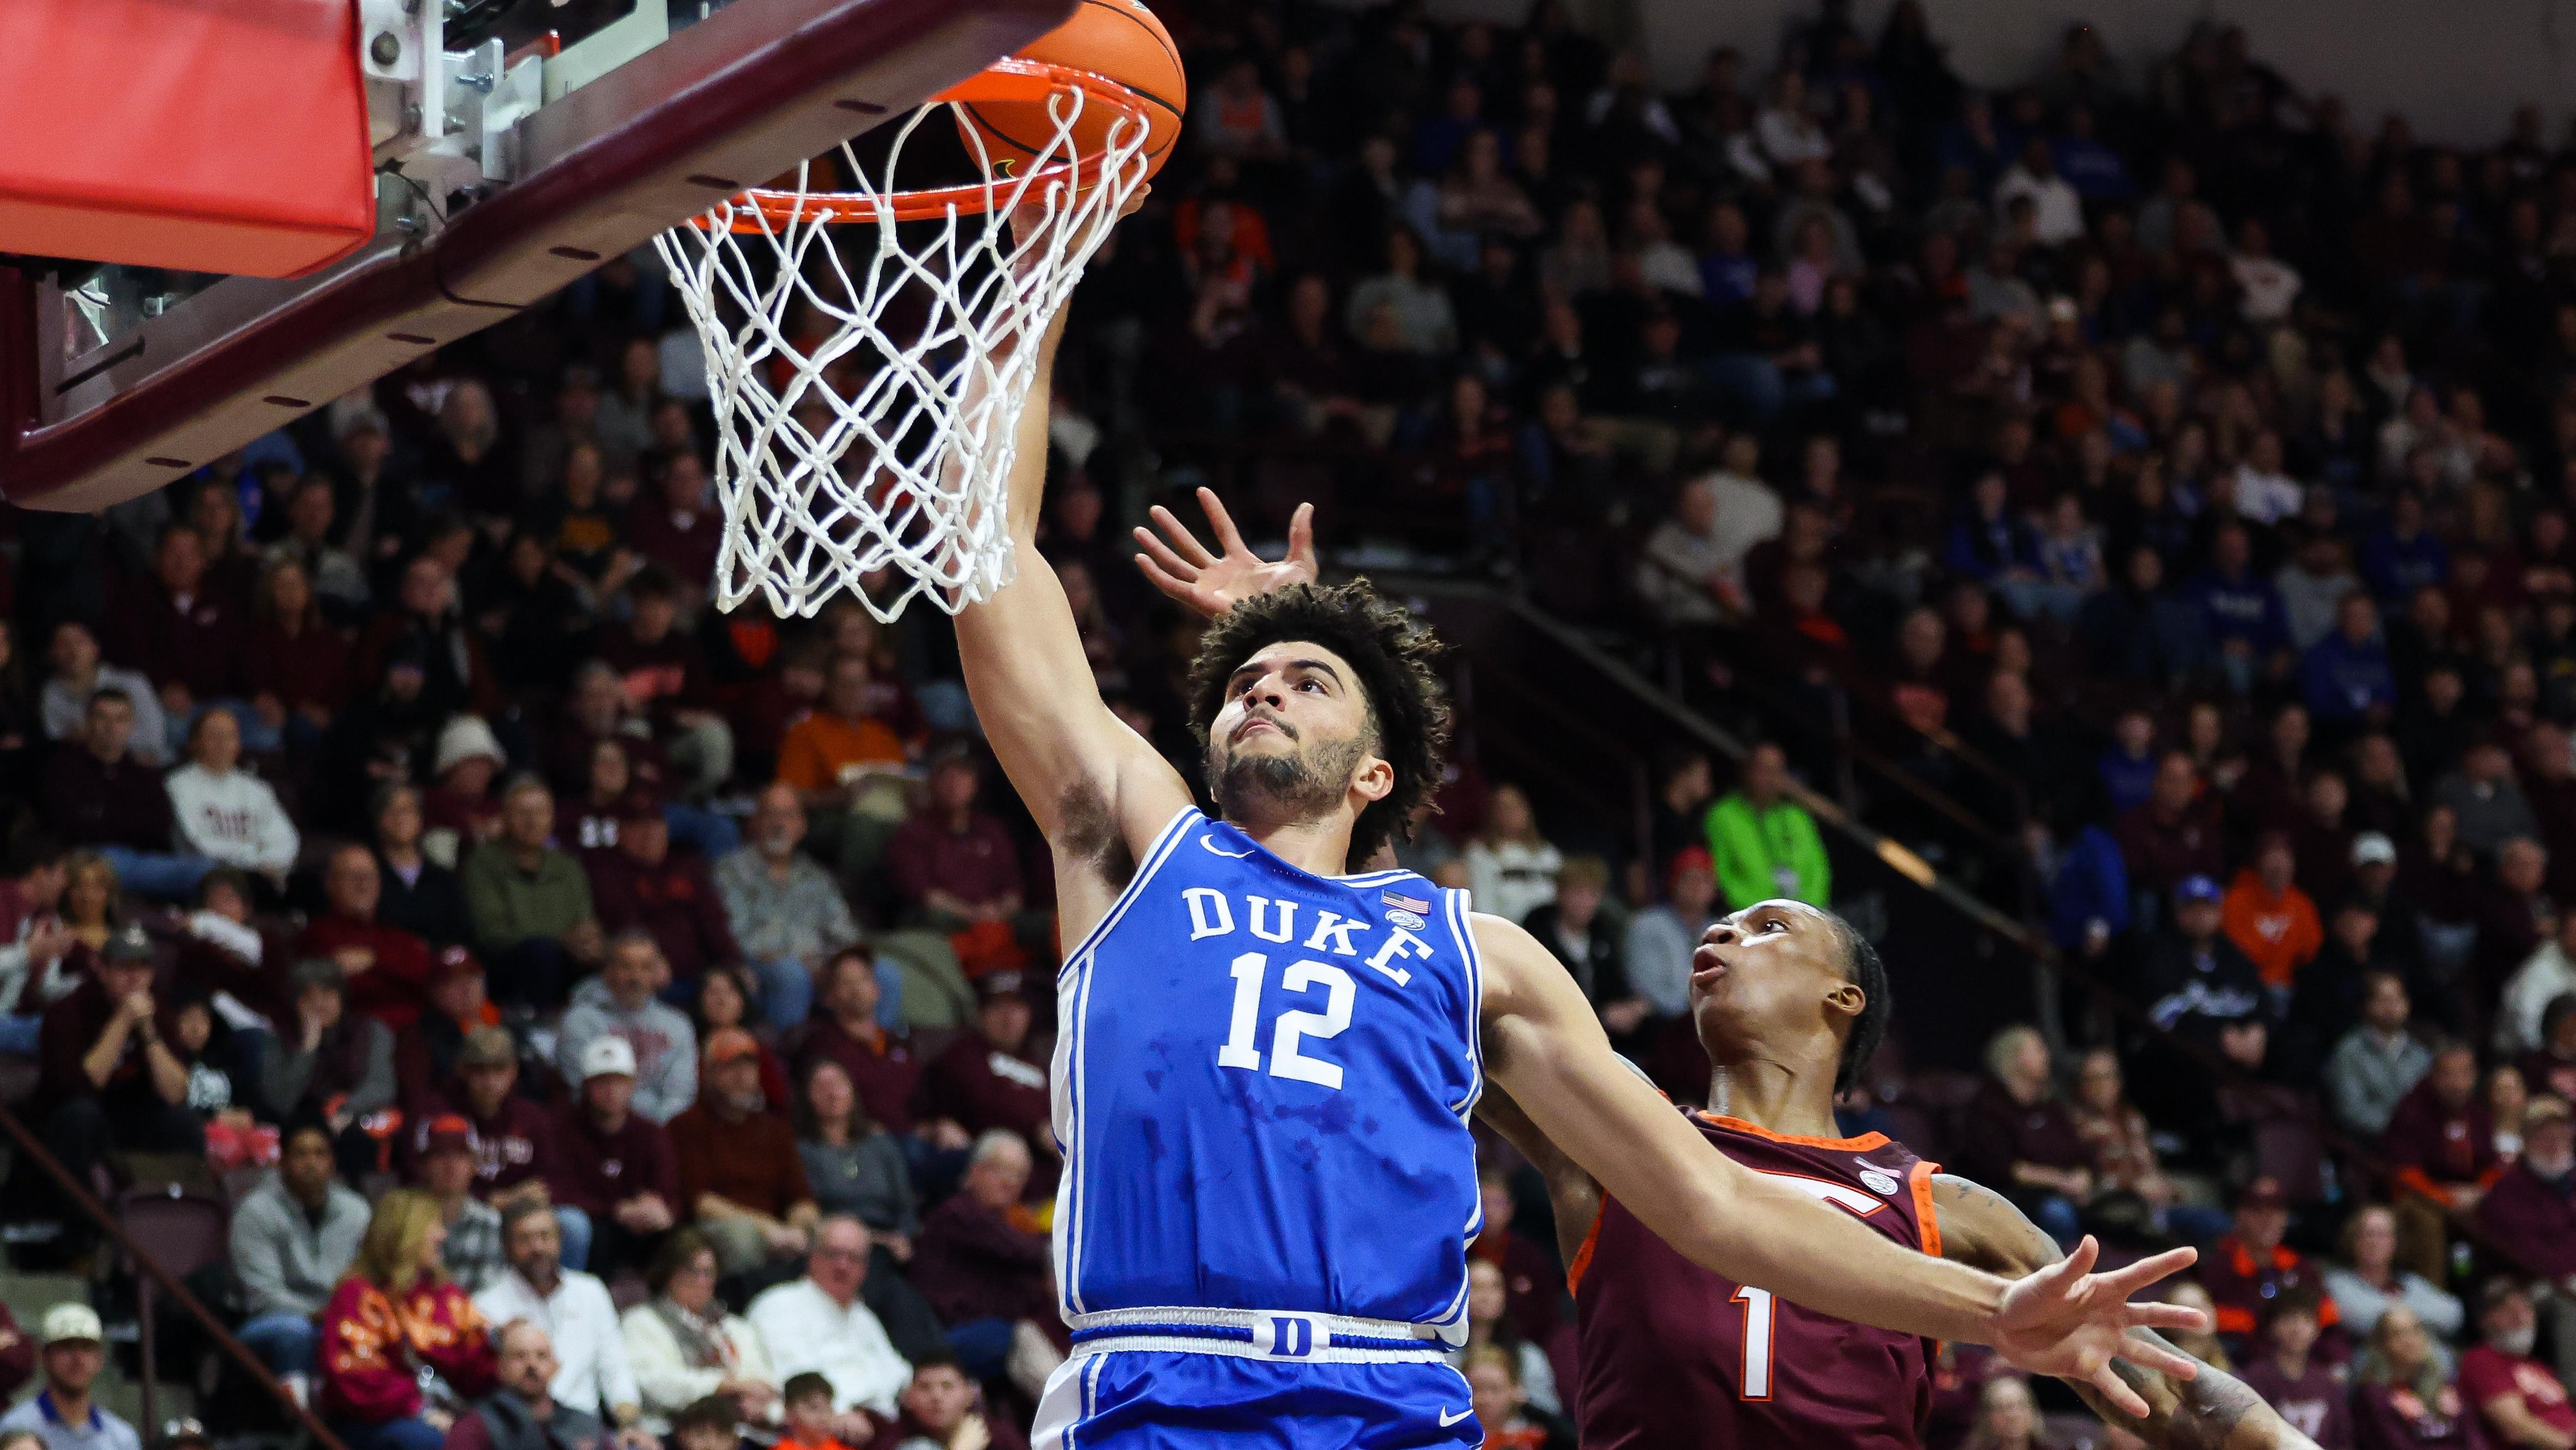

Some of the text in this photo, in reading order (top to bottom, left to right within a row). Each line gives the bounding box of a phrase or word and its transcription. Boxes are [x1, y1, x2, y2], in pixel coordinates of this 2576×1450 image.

[1182, 887, 1434, 988] DUKE
[1218, 951, 1356, 1090] 12
[1269, 1317, 1311, 1357] D
[1729, 1284, 1777, 1402] 1
